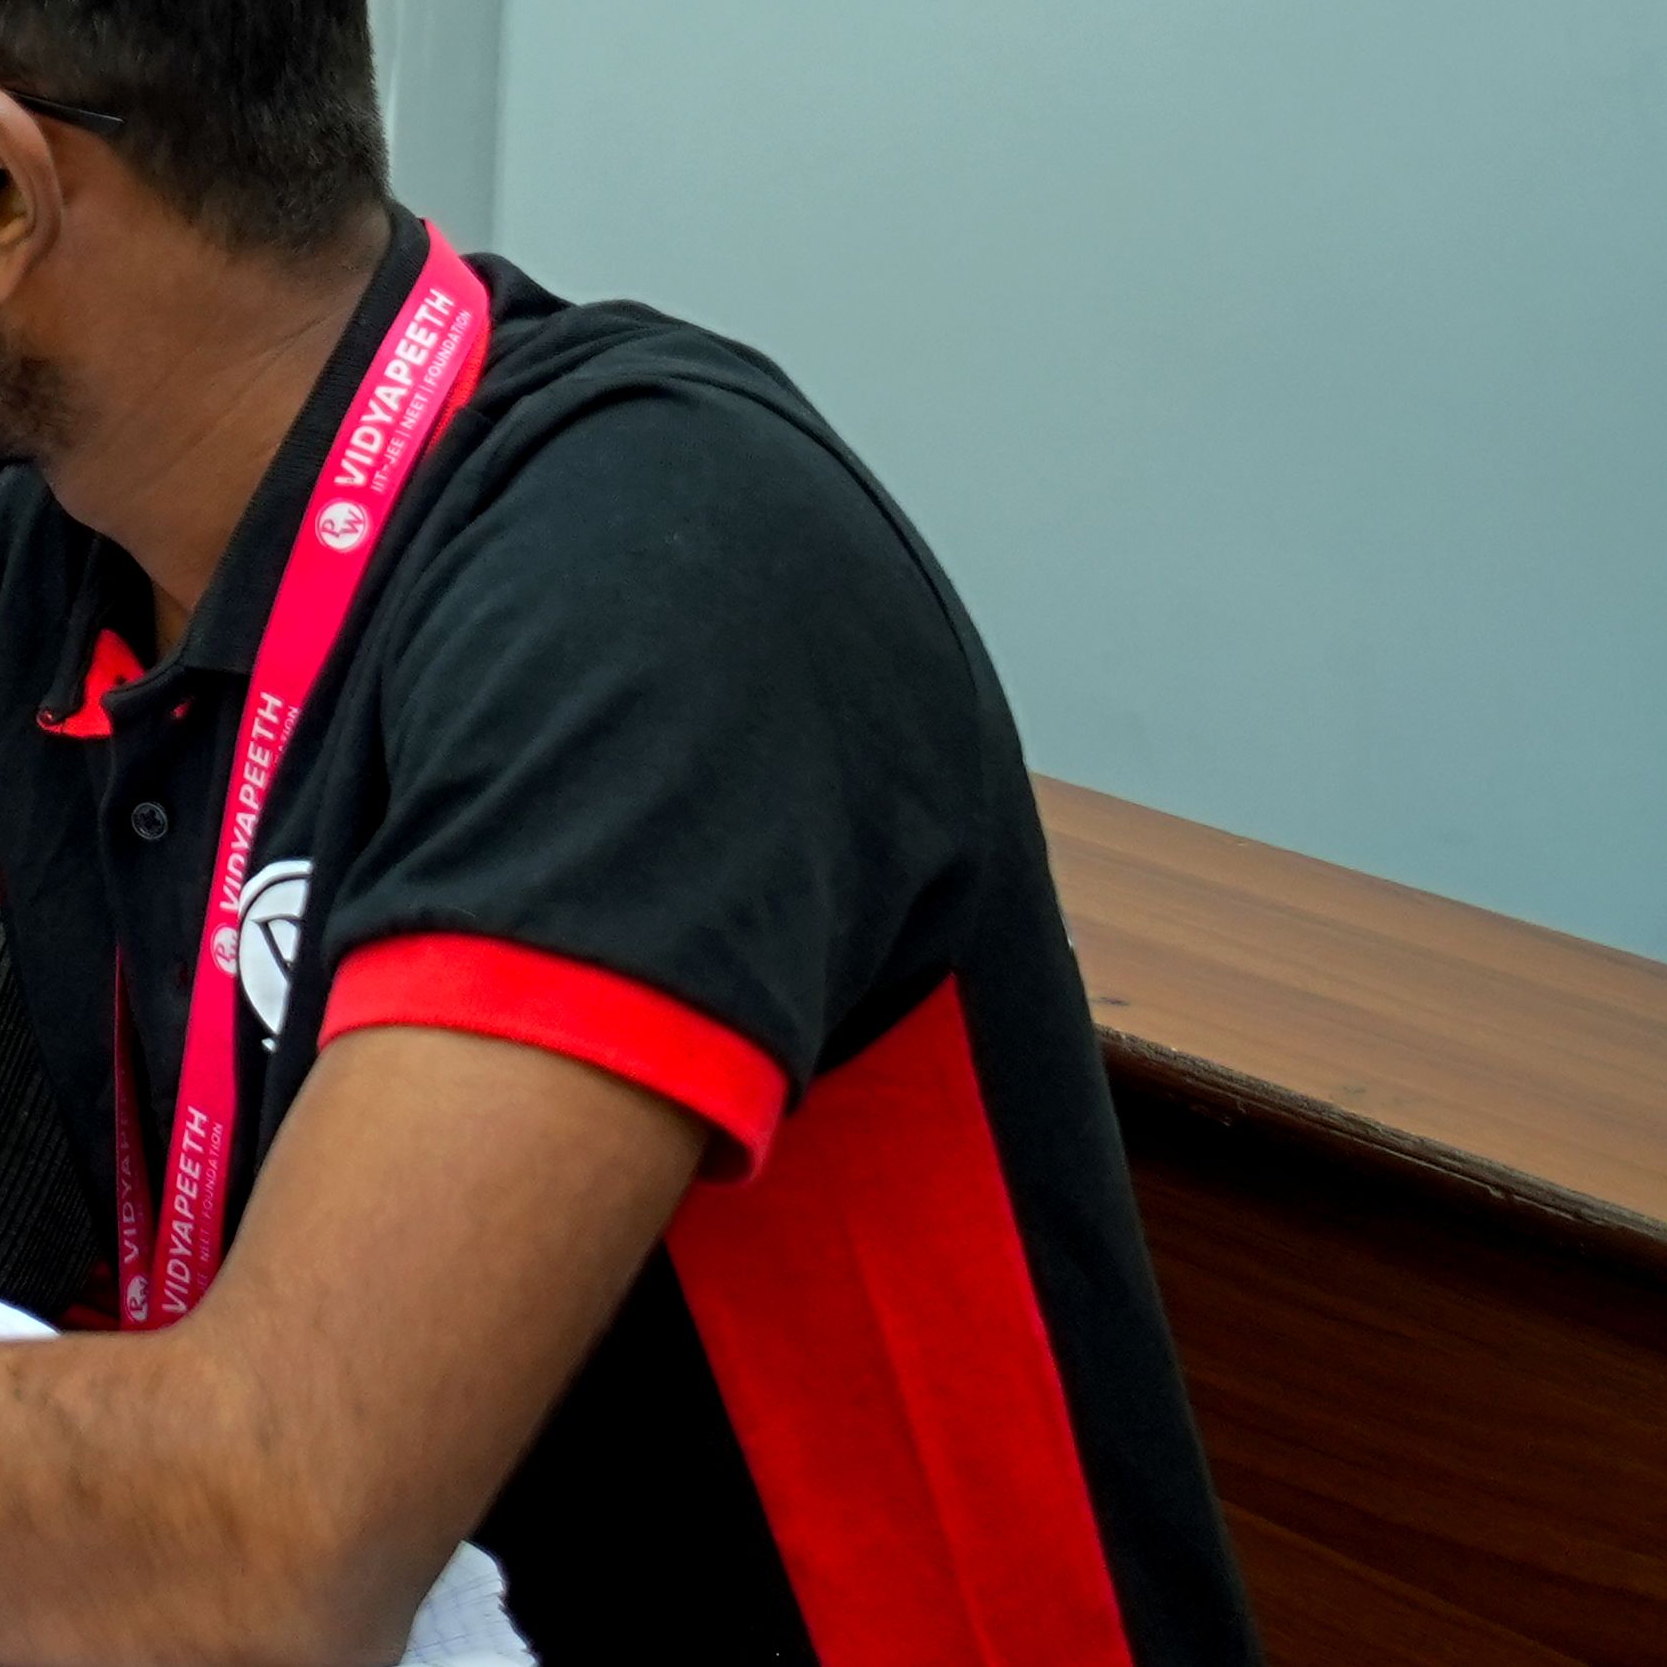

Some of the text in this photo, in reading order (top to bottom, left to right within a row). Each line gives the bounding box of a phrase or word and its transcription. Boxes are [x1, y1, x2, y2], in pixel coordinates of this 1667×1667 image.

[333, 287, 455, 487] VIDYAPEETH
[370, 309, 472, 493] IIT-JEE NEET FOUNDATION
[219, 691, 283, 915] VIDYAPEETH
[160, 1106, 208, 1315] VIDYAPEETH
